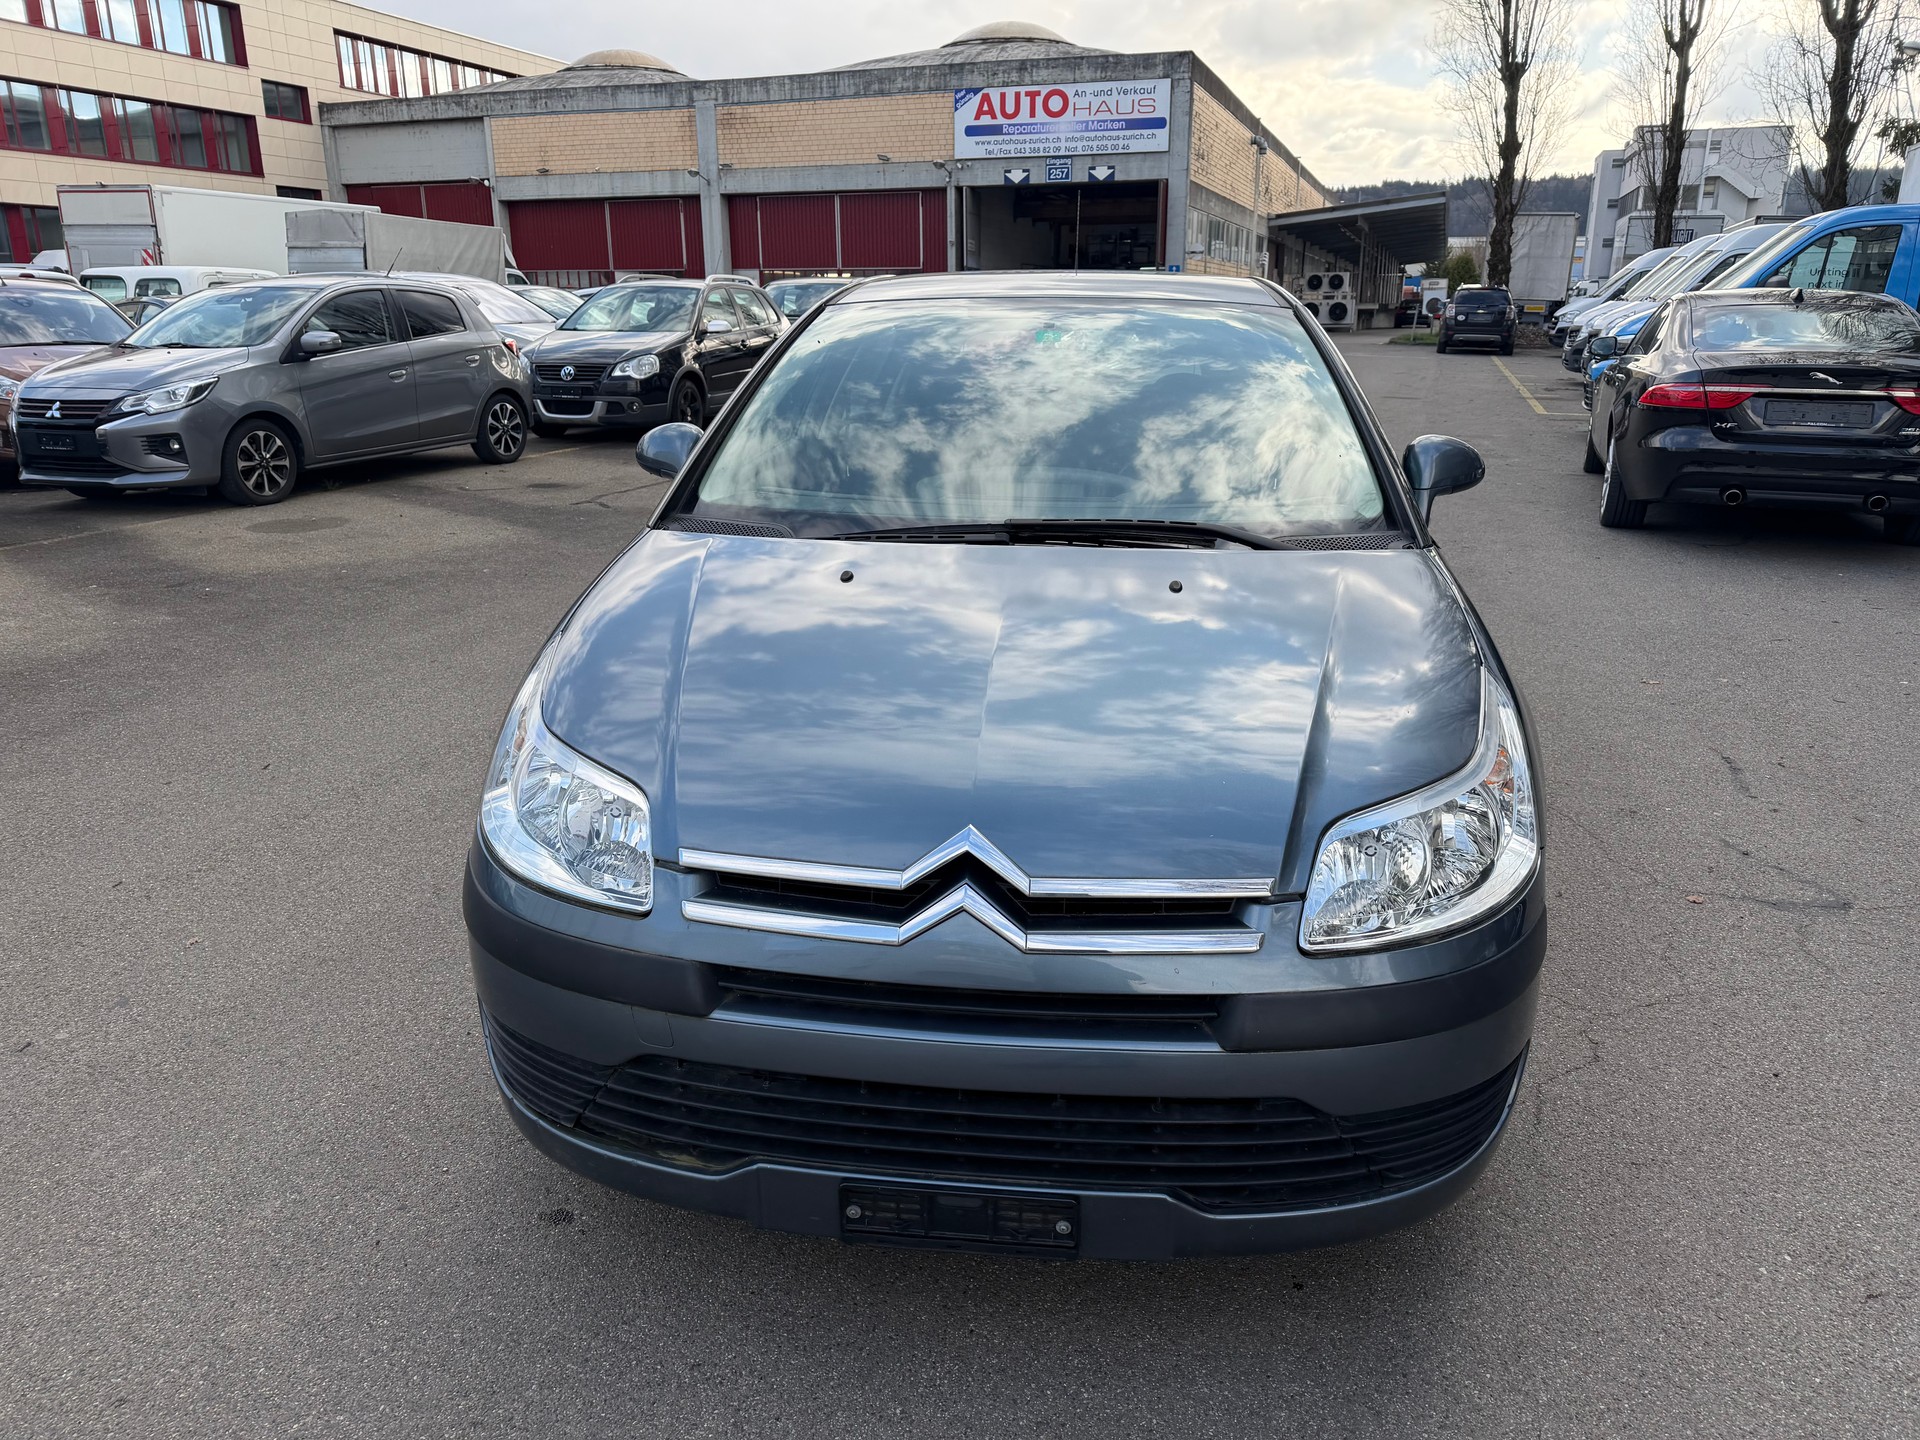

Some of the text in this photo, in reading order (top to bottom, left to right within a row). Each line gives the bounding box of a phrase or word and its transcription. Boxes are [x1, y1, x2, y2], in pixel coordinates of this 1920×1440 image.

[1073, 89, 1086, 98] An
[1115, 85, 1157, 96] Verkauf
[973, 88, 1070, 121] AUTO
[1072, 97, 1156, 117] HAUS
[1002, 123, 1062, 135] Reparature
[1088, 119, 1126, 131] Marken
[1064, 132, 1157, 143] info@autohaus-zurich.ch
[1013, 147, 1027, 155] 043
[1042, 146, 1052, 154] 82
[1052, 145, 1062, 154] 09
[1064, 145, 1080, 153] Nat.
[1081, 144, 1094, 152] 076
[1096, 144, 1109, 152] 505
[1110, 143, 1120, 151] 00
[1121, 143, 1131, 151] 46
[1046, 158, 1072, 166] Eingang
[1049, 168, 1069, 179] 257
